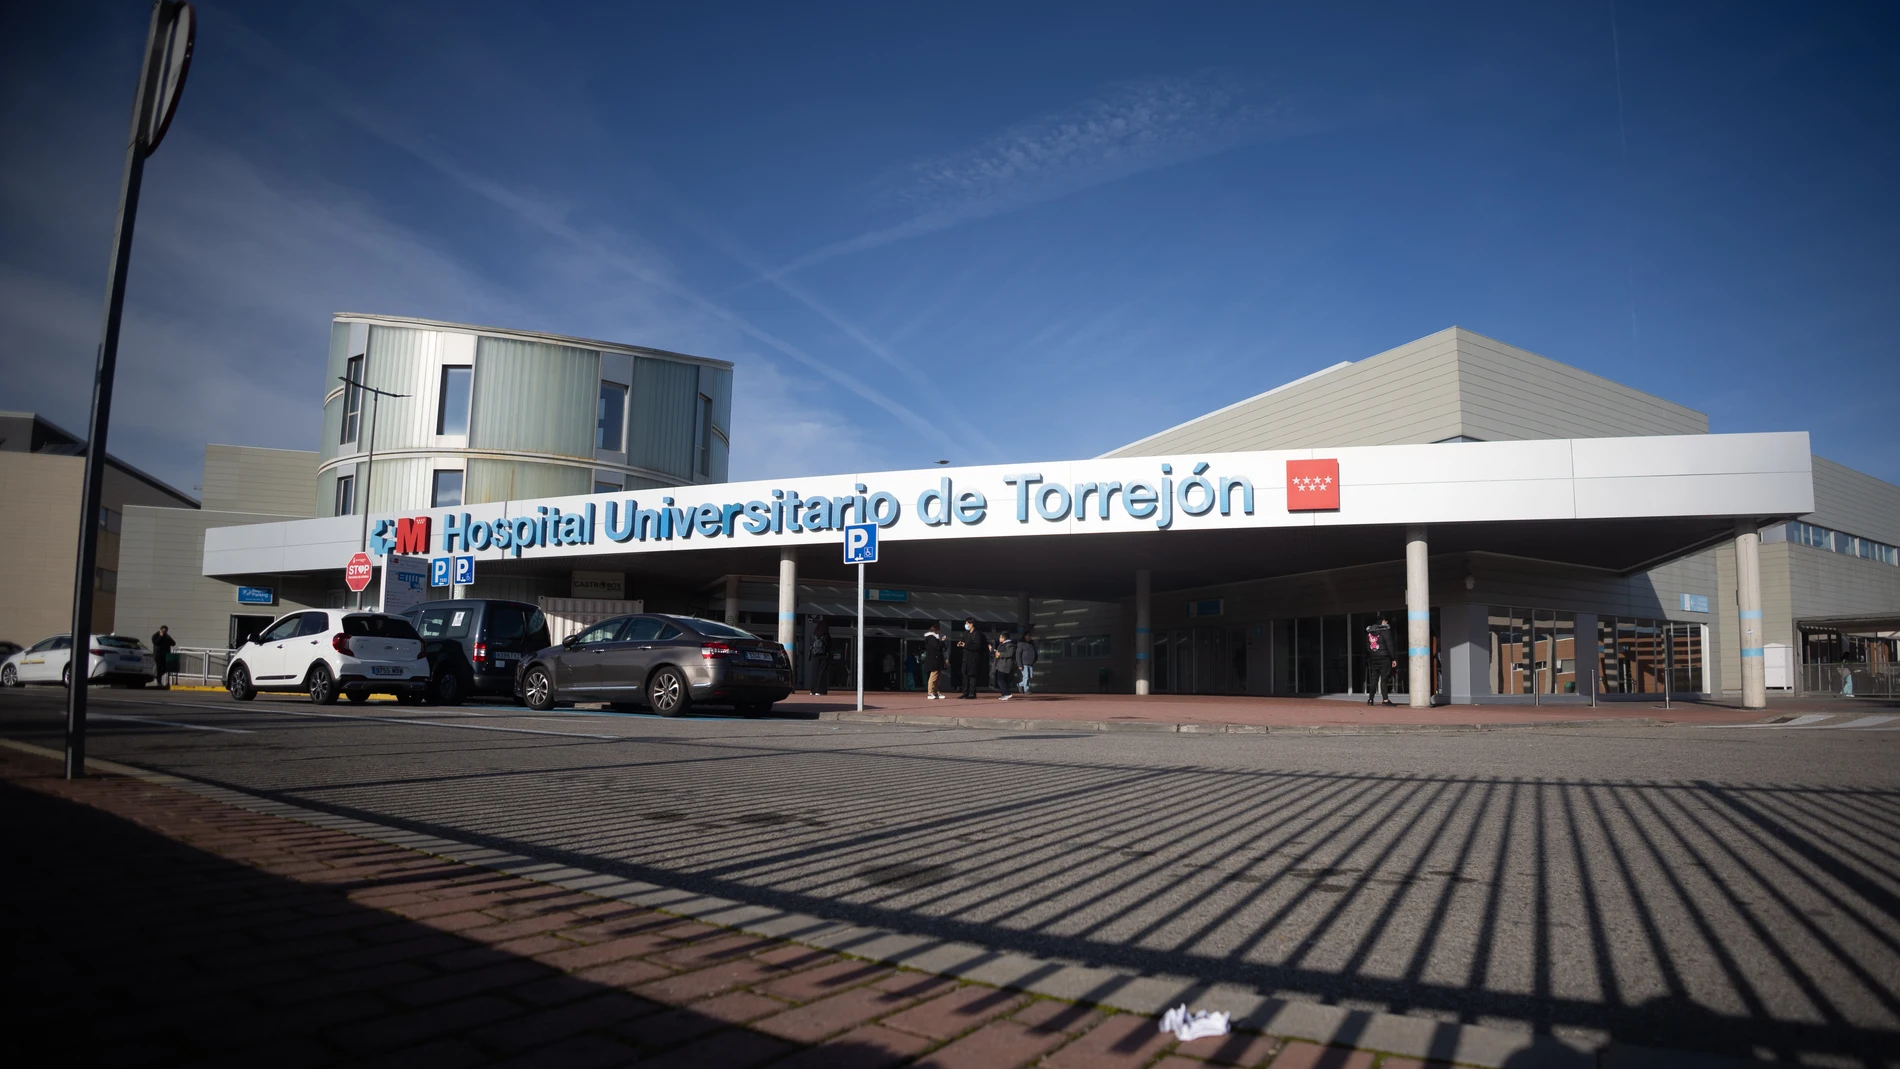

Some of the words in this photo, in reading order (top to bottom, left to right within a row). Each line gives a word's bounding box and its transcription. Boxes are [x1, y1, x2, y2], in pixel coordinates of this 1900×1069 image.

[442, 502, 596, 557] Hospital
[604, 482, 901, 543] Universitario
[916, 476, 988, 526] de
[1003, 461, 1256, 530] Torrejón
[848, 528, 869, 559] P
[434, 560, 447, 583] P
[456, 558, 469, 582] P
